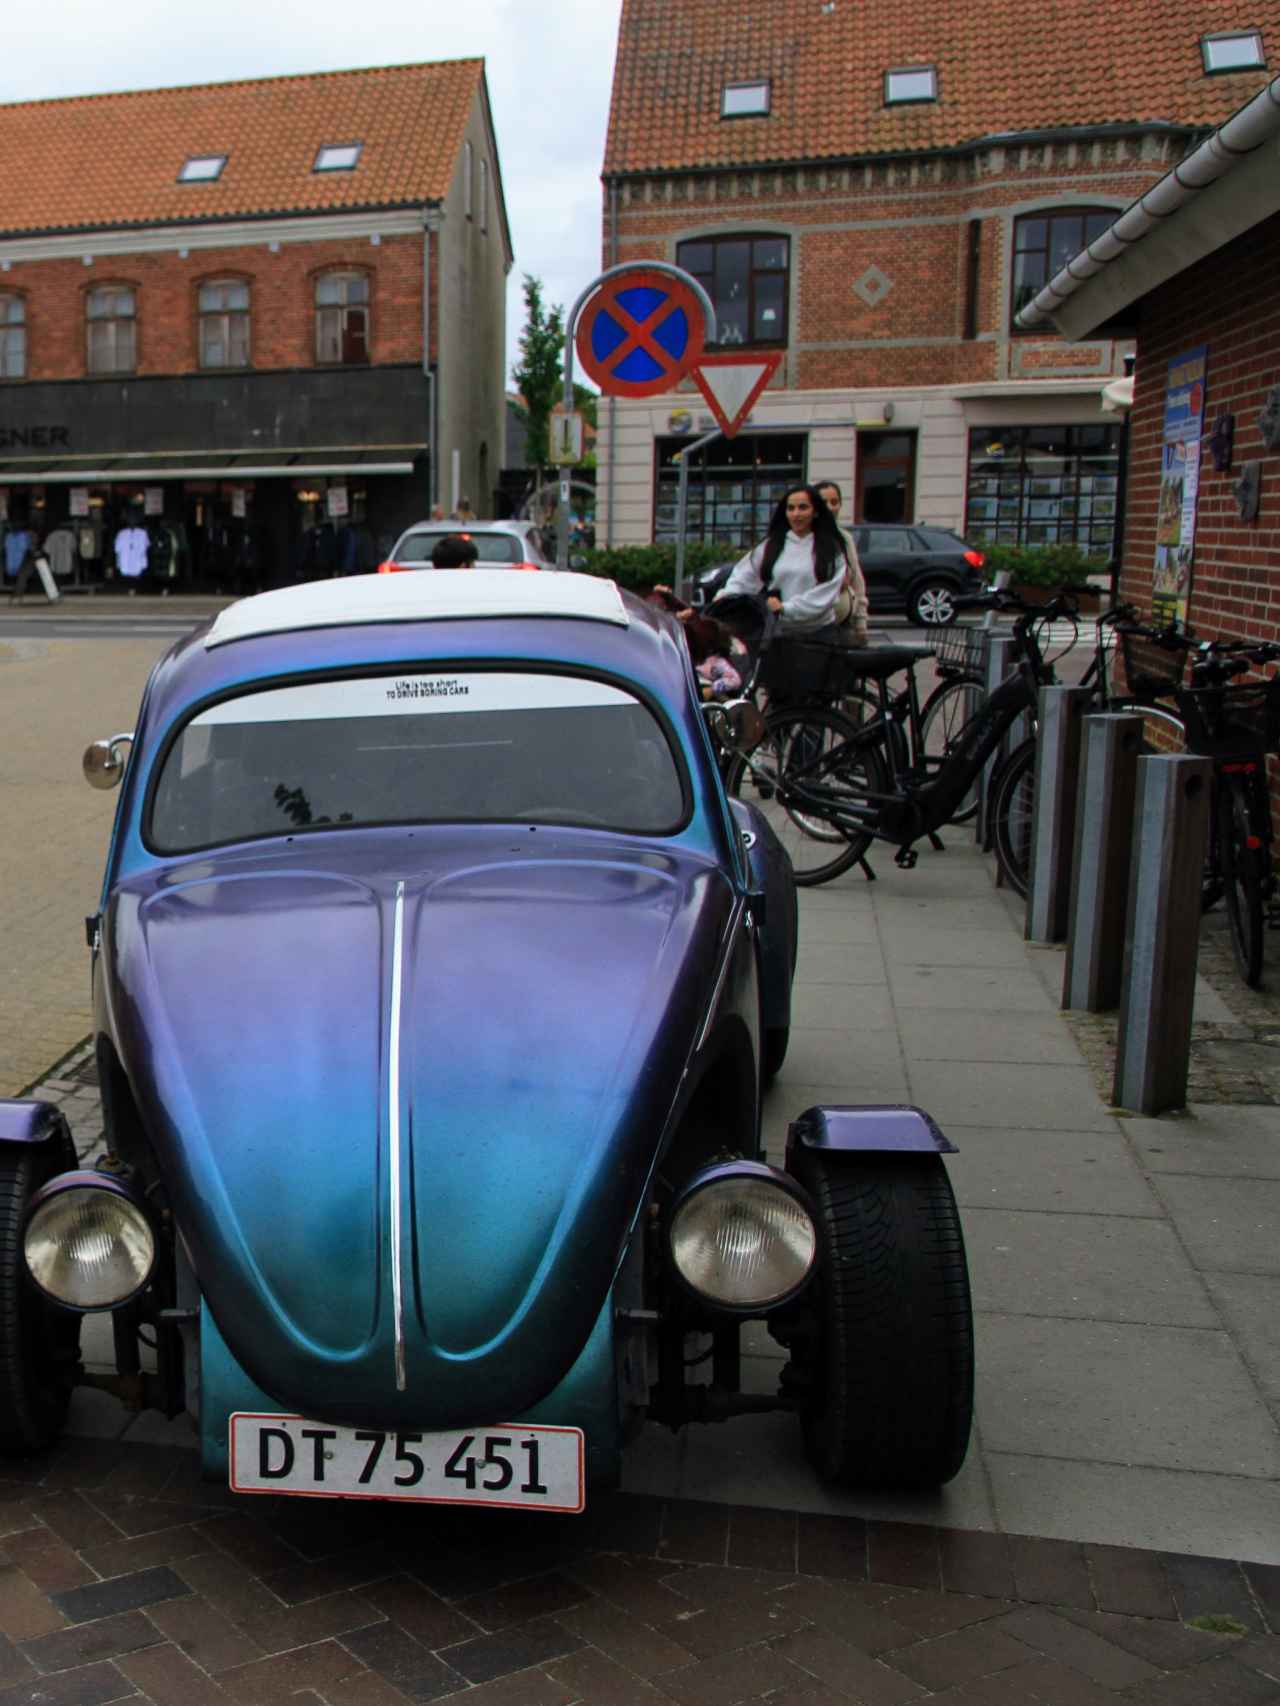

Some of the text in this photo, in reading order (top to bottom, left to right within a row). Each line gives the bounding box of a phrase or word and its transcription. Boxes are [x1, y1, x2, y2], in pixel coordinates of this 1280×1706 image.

[395, 679, 458, 690] Life is too short
[386, 686, 469, 699] TO DRIVE BORING CARS
[258, 1427, 548, 1494] DT 75 451
